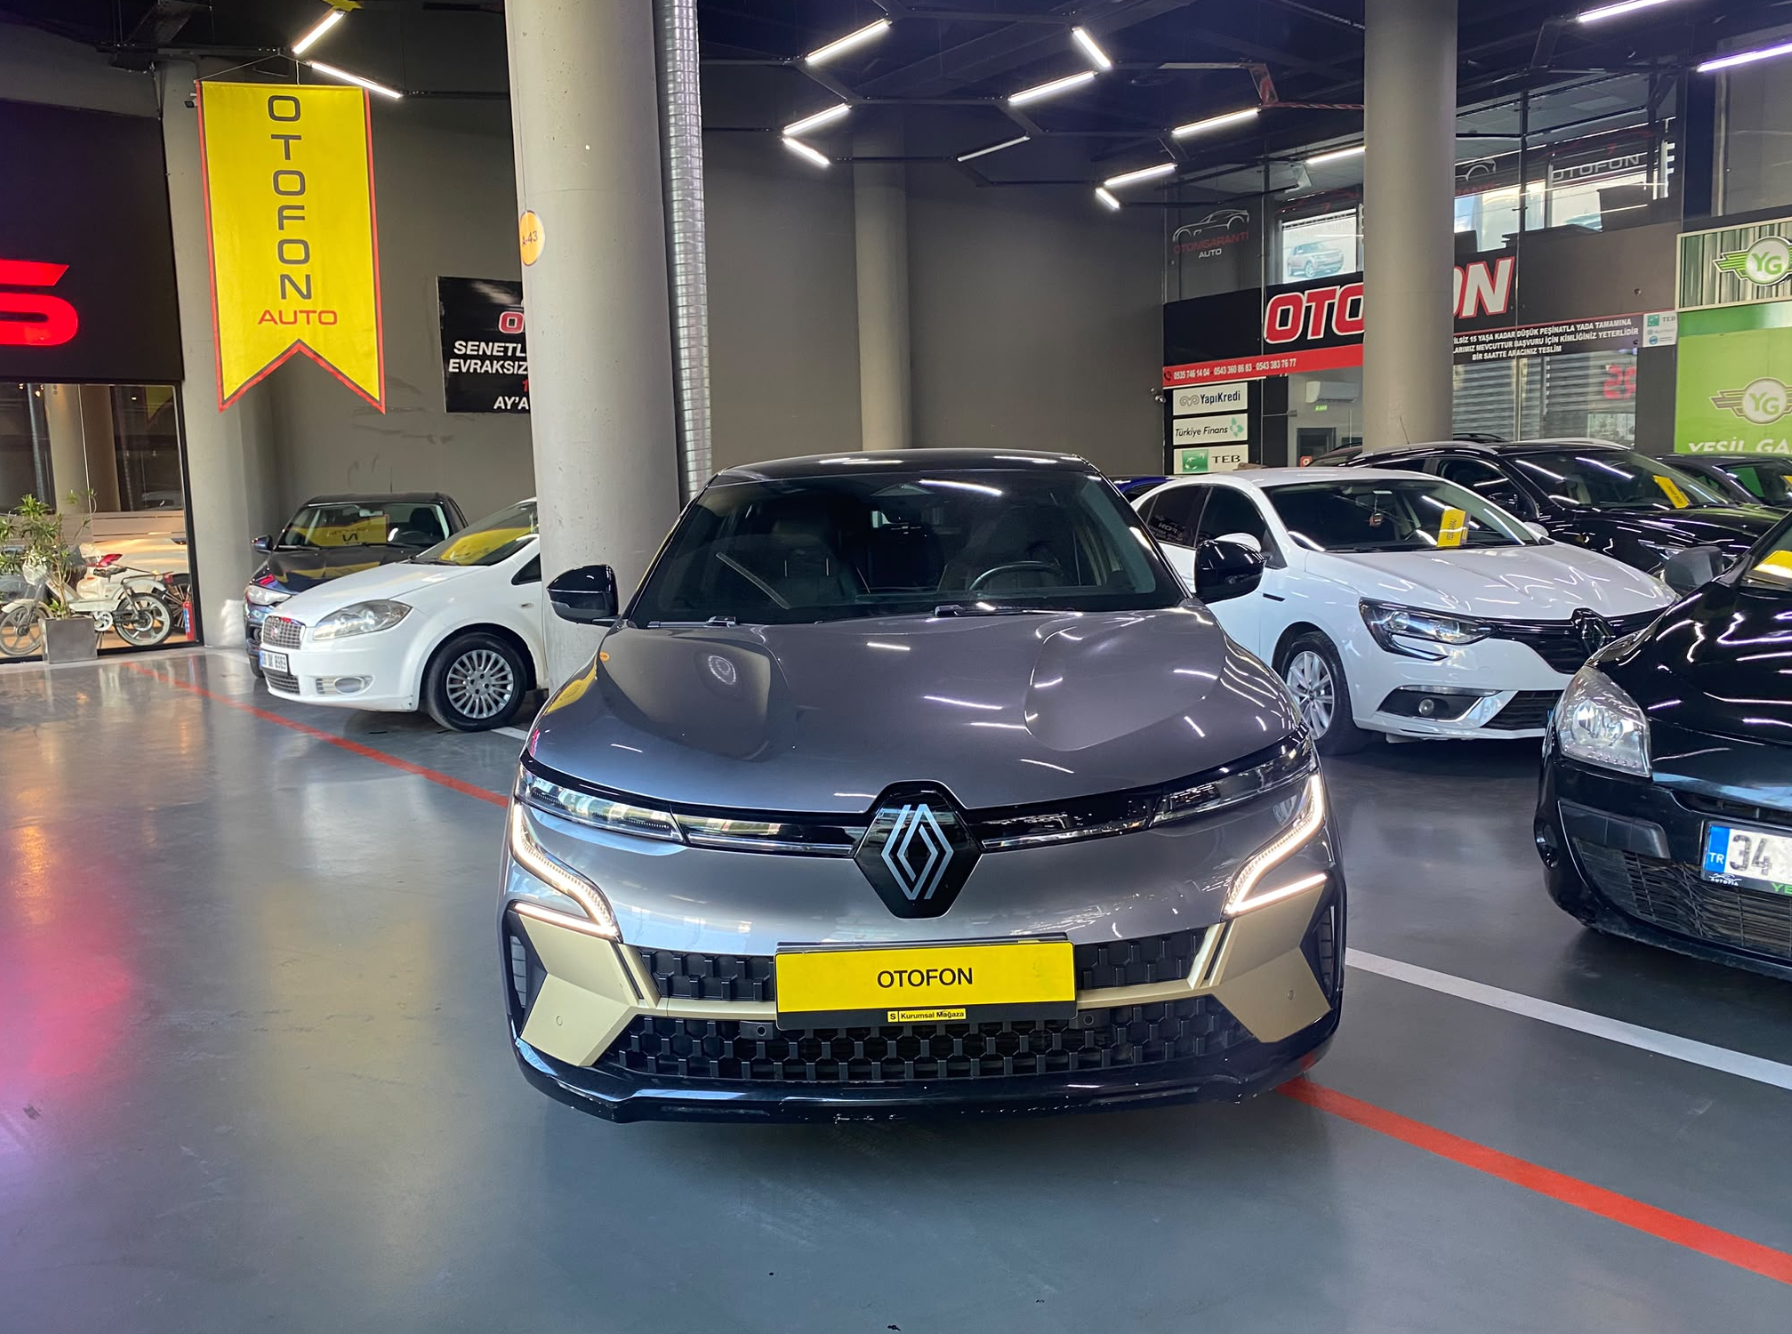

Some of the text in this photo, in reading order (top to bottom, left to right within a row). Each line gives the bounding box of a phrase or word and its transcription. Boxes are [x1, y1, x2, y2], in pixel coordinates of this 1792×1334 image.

[267, 95, 312, 300] OTOFON
[1199, 248, 1222, 258] AUTO
[1751, 251, 1782, 276] YG
[258, 309, 338, 325] AUTO
[1494, 331, 1515, 340] KADAR
[1517, 328, 1539, 337] DÜŞÜK
[1540, 324, 1575, 335] PEŞİNATLA
[1576, 322, 1594, 331] YADA
[1595, 318, 1632, 329] TAMAMINA
[1476, 341, 1513, 351] MEVCUTTUR
[1514, 338, 1544, 347] BAŞVURU
[1545, 335, 1559, 345] İÇİN
[1598, 327, 1639, 338] YETERLİDİR
[1472, 345, 1562, 360] BİR SAATTE ARACINIZ TESLİM
[449, 359, 528, 375] EVRAKSIZ
[1289, 358, 1297, 367] 77
[1748, 392, 1780, 416] YG
[1175, 426, 1228, 437] Türkiye Finans
[1756, 438, 1792, 454] GA
[1212, 455, 1241, 463] TEB
[1708, 834, 1773, 876] TR 34
[877, 967, 973, 989] OTOFON
[901, 1012, 934, 1020] Kurumsal
[937, 1010, 964, 1018] Mağaza
